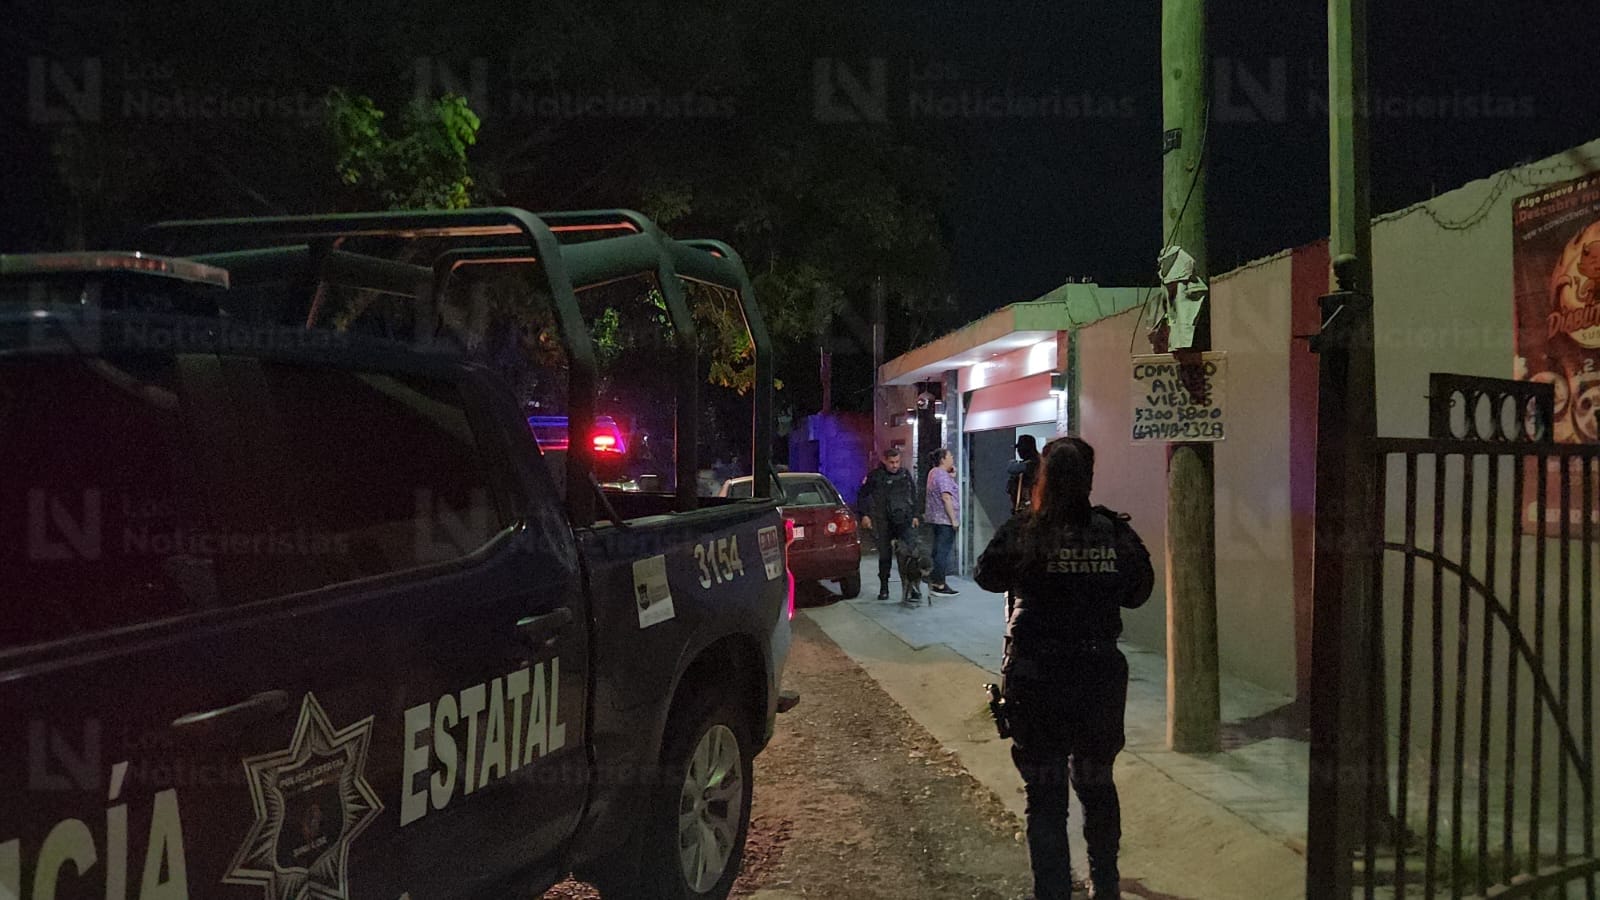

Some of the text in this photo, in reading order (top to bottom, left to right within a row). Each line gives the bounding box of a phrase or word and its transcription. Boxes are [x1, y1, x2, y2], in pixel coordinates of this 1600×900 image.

[1543, 185, 1573, 201] nuevo
[1134, 362, 1217, 380] COMO
[693, 534, 745, 589] 3154
[1047, 561, 1119, 573] ESTATAL
[400, 656, 566, 828] ESTATAL
